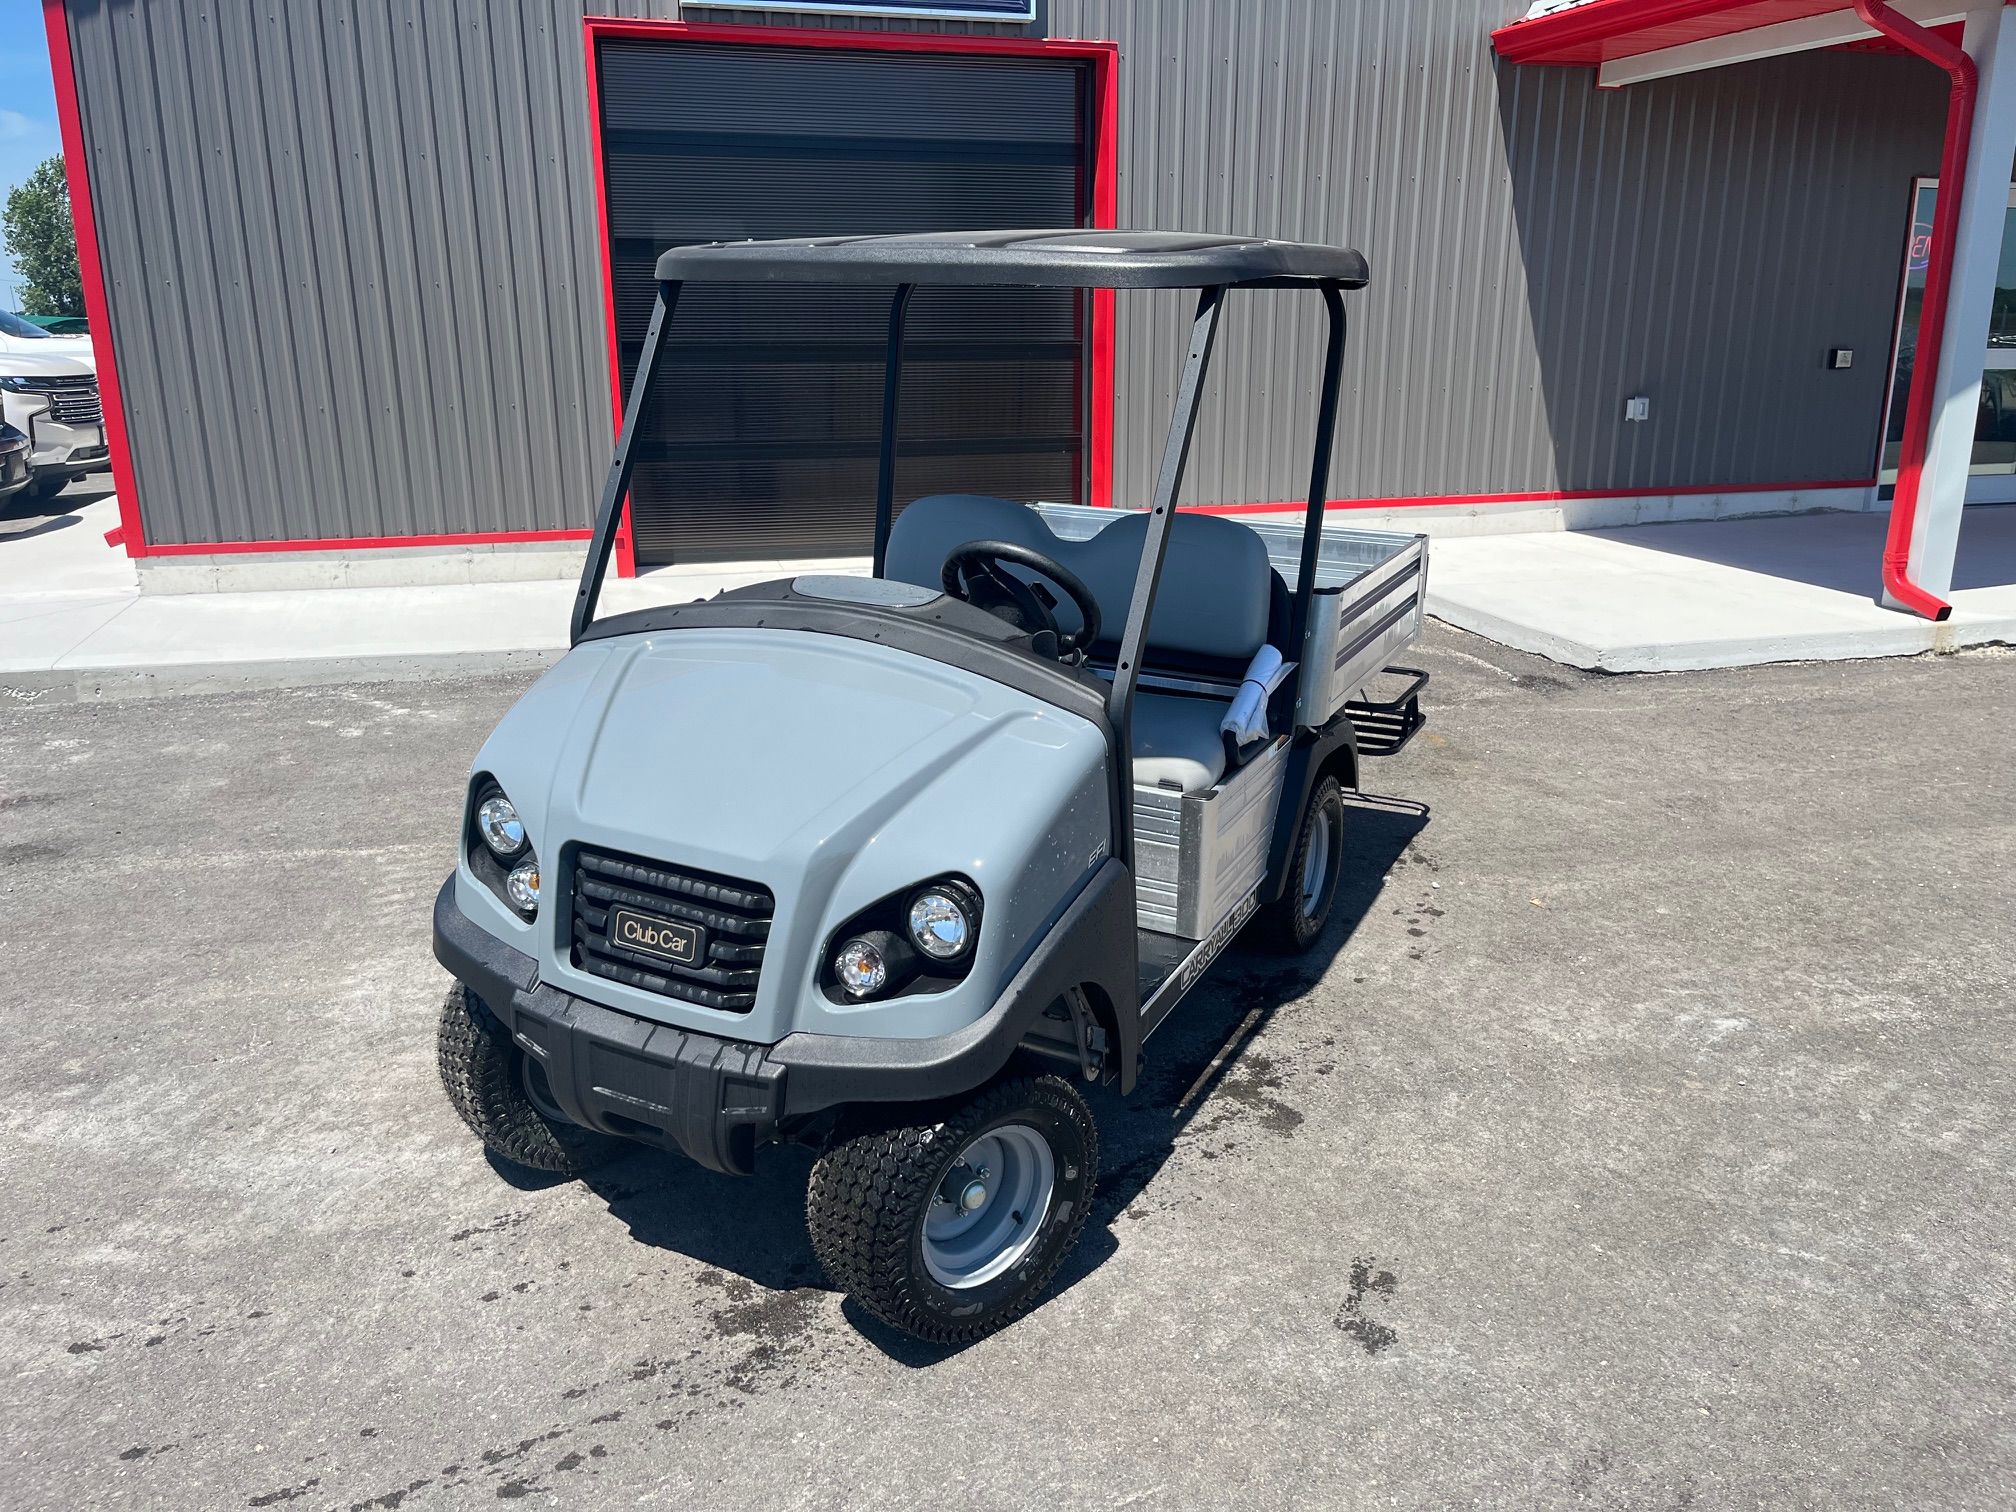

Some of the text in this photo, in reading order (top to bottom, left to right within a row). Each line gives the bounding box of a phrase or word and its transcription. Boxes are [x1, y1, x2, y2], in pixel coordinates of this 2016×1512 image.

[1088, 838, 1106, 869] EFI
[624, 920, 688, 953] Club Car
[1181, 889, 1256, 989] CARRYALL 300
